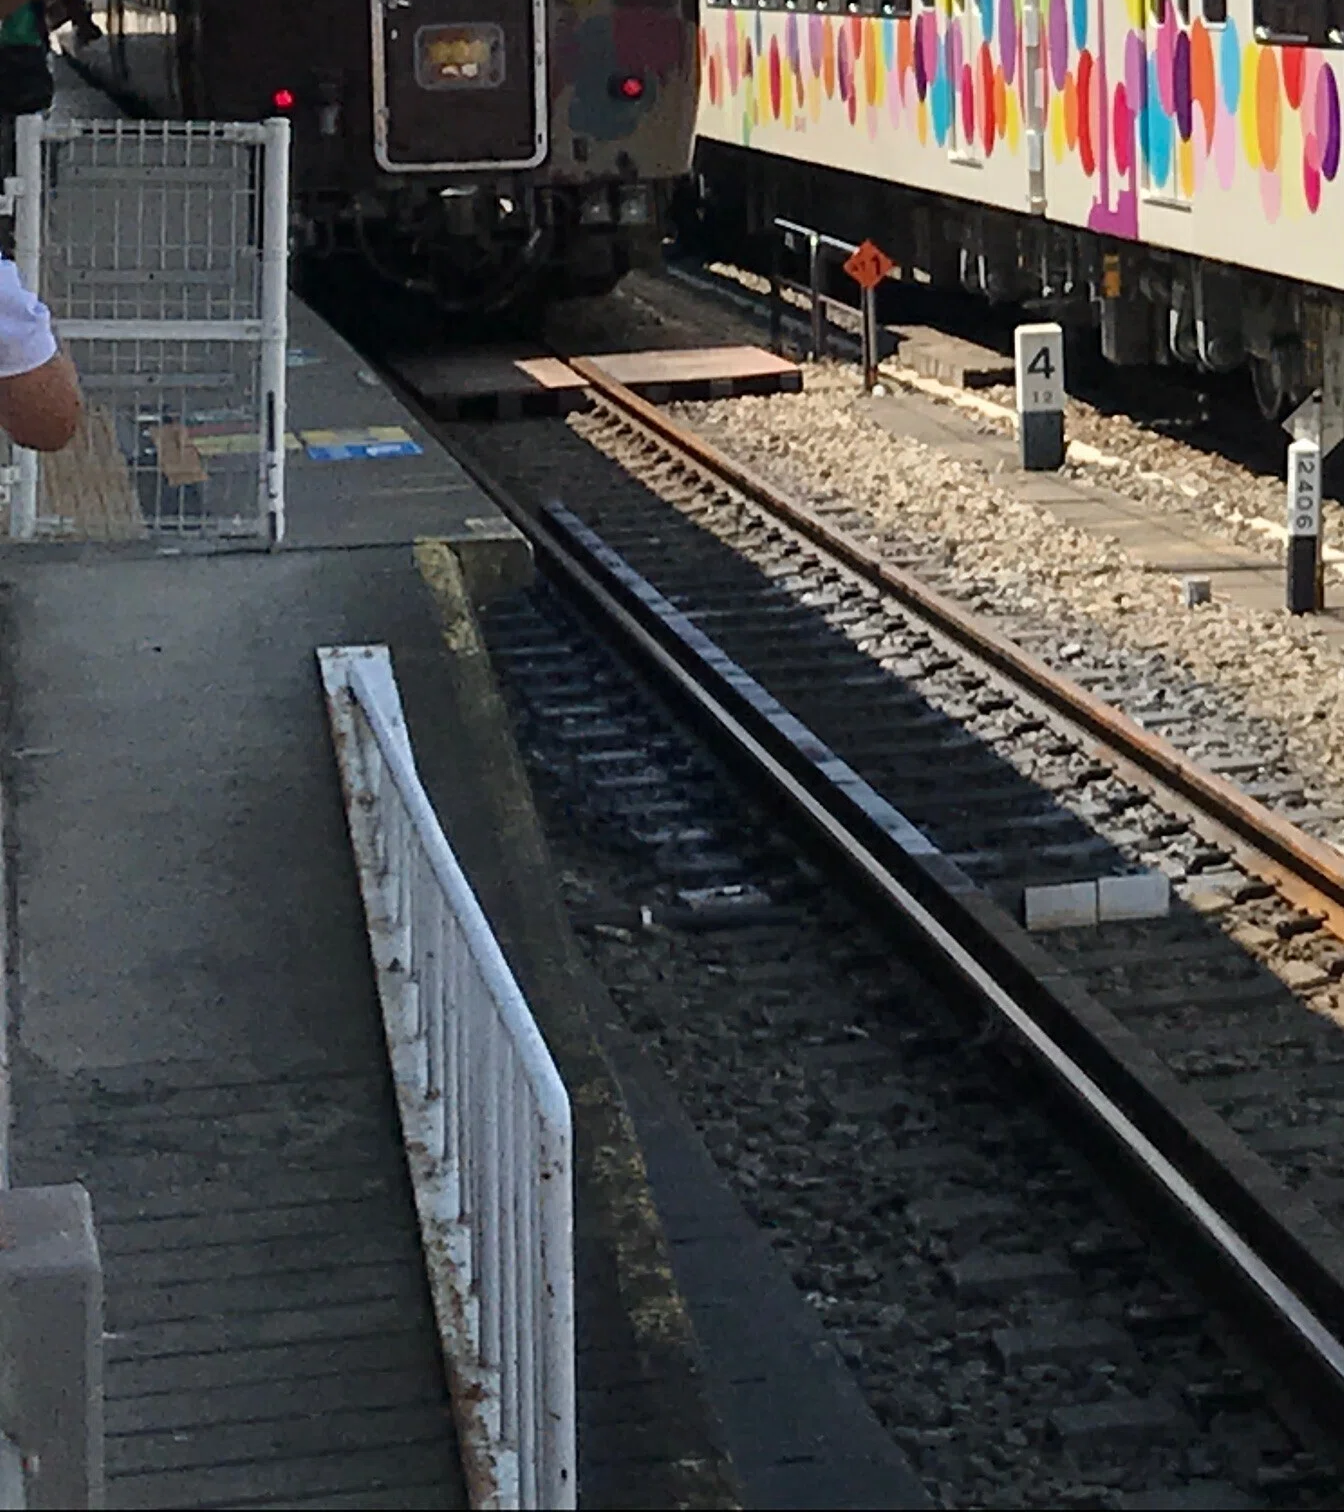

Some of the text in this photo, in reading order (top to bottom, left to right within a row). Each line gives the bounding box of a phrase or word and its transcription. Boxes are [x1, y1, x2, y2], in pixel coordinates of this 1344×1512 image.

[1027, 346, 1055, 380] 4
[1033, 390, 1053, 404] 12
[1295, 451, 1315, 529] 12406
